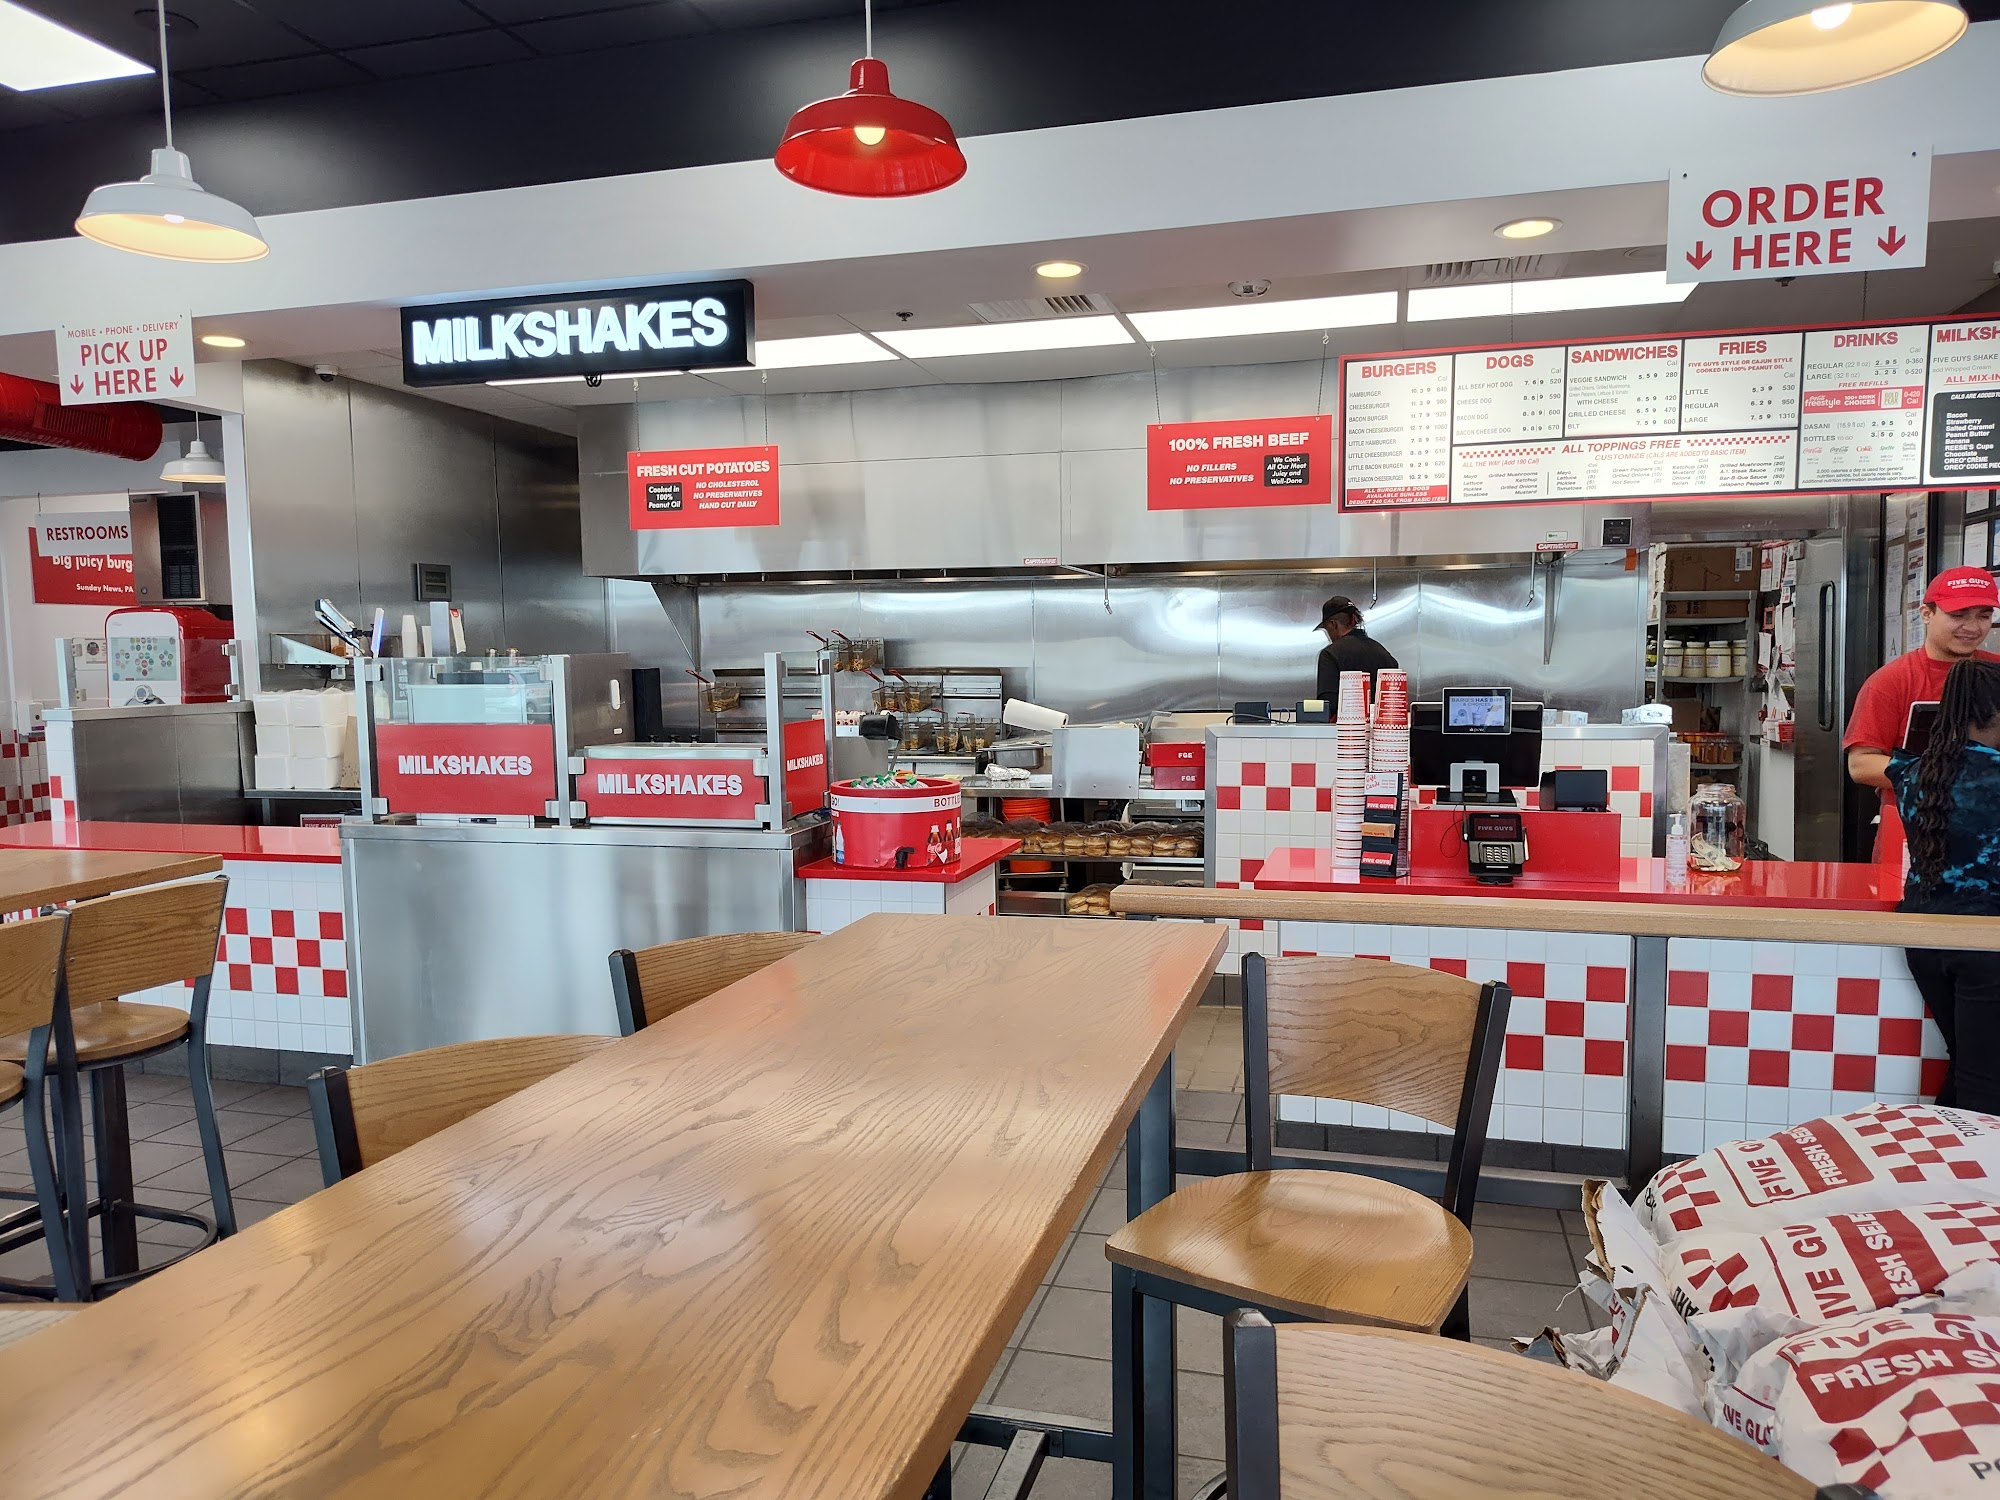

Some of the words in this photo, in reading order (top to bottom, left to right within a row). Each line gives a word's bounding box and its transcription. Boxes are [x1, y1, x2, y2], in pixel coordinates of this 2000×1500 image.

[1702, 177, 1886, 228] ORDER
[1733, 228, 1853, 271] HERE
[67, 328, 96, 338] MOBILE
[105, 325, 133, 335] PHONE
[142, 321, 179, 332] DELIVERY
[412, 297, 729, 366] MILKSHAKES
[1718, 340, 1767, 355] FRIES
[1833, 331, 1899, 348] DRINKS
[80, 341, 131, 367] PICK
[139, 338, 168, 362] UP
[1571, 344, 1678, 364] SANDWICHES
[1972, 353, 1998, 361] SHAKE
[1486, 353, 1534, 369] DOGS
[1806, 362, 1843, 370] REGULAR
[1361, 361, 1436, 378] BURGERS
[1806, 373, 1832, 381] LARGE
[94, 367, 157, 396] HERE
[1569, 376, 1593, 384] VEGGIE
[1593, 374, 1627, 382] SANDWICH
[1349, 402, 1390, 410] CHEESEBURGER
[1805, 397, 1841, 408] freestyle
[1568, 410, 1598, 418] GRILLED
[1168, 437, 1209, 452] 100%
[1212, 435, 1264, 450] FRESH
[1267, 432, 1309, 447] BEEF
[1561, 444, 1584, 454] ALL
[1587, 441, 1647, 452] TOPPINGS
[1649, 439, 1682, 449] FREE
[1364, 450, 1403, 458] CHEESEBURGER
[1594, 452, 1645, 461] CUSTOMIZE
[636, 464, 678, 478] FRESH
[678, 463, 705, 476] CUT
[706, 460, 771, 475] POTATOES
[1186, 464, 1199, 473] NO
[1200, 463, 1237, 472] FILLERS
[707, 479, 760, 488] CHOLESTEROL
[1169, 477, 1183, 485] NO
[1184, 475, 1254, 485] PRESERVATIVES
[706, 490, 763, 499] PRESERVATIVES
[648, 501, 671, 509] Peanut
[737, 500, 758, 508] DAILY
[46, 525, 129, 541] RESTROOMS
[75, 555, 103, 571] juicy
[107, 554, 133, 573] burg
[76, 583, 102, 593] Sunday
[1947, 579, 1967, 587] FIVE
[1968, 577, 1990, 586] GUYS
[1889, 637, 1897, 656] A
[398, 754, 532, 775] MILKSHAKES
[786, 753, 824, 772] MILKSHAKES
[597, 773, 743, 796] MILKSHAKES
[1366, 774, 1377, 783] Gift
[1366, 781, 1380, 790] Cards
[1801, 1143, 1848, 1187] FRESH
[1746, 1157, 1794, 1198] FIVE
[1782, 1224, 1828, 1258] GU
[1804, 1267, 1859, 1320] IVE
[1787, 1318, 1914, 1356] FIVE
[1808, 1349, 1953, 1395] FRESH
[1723, 1403, 1742, 1432] IVE
